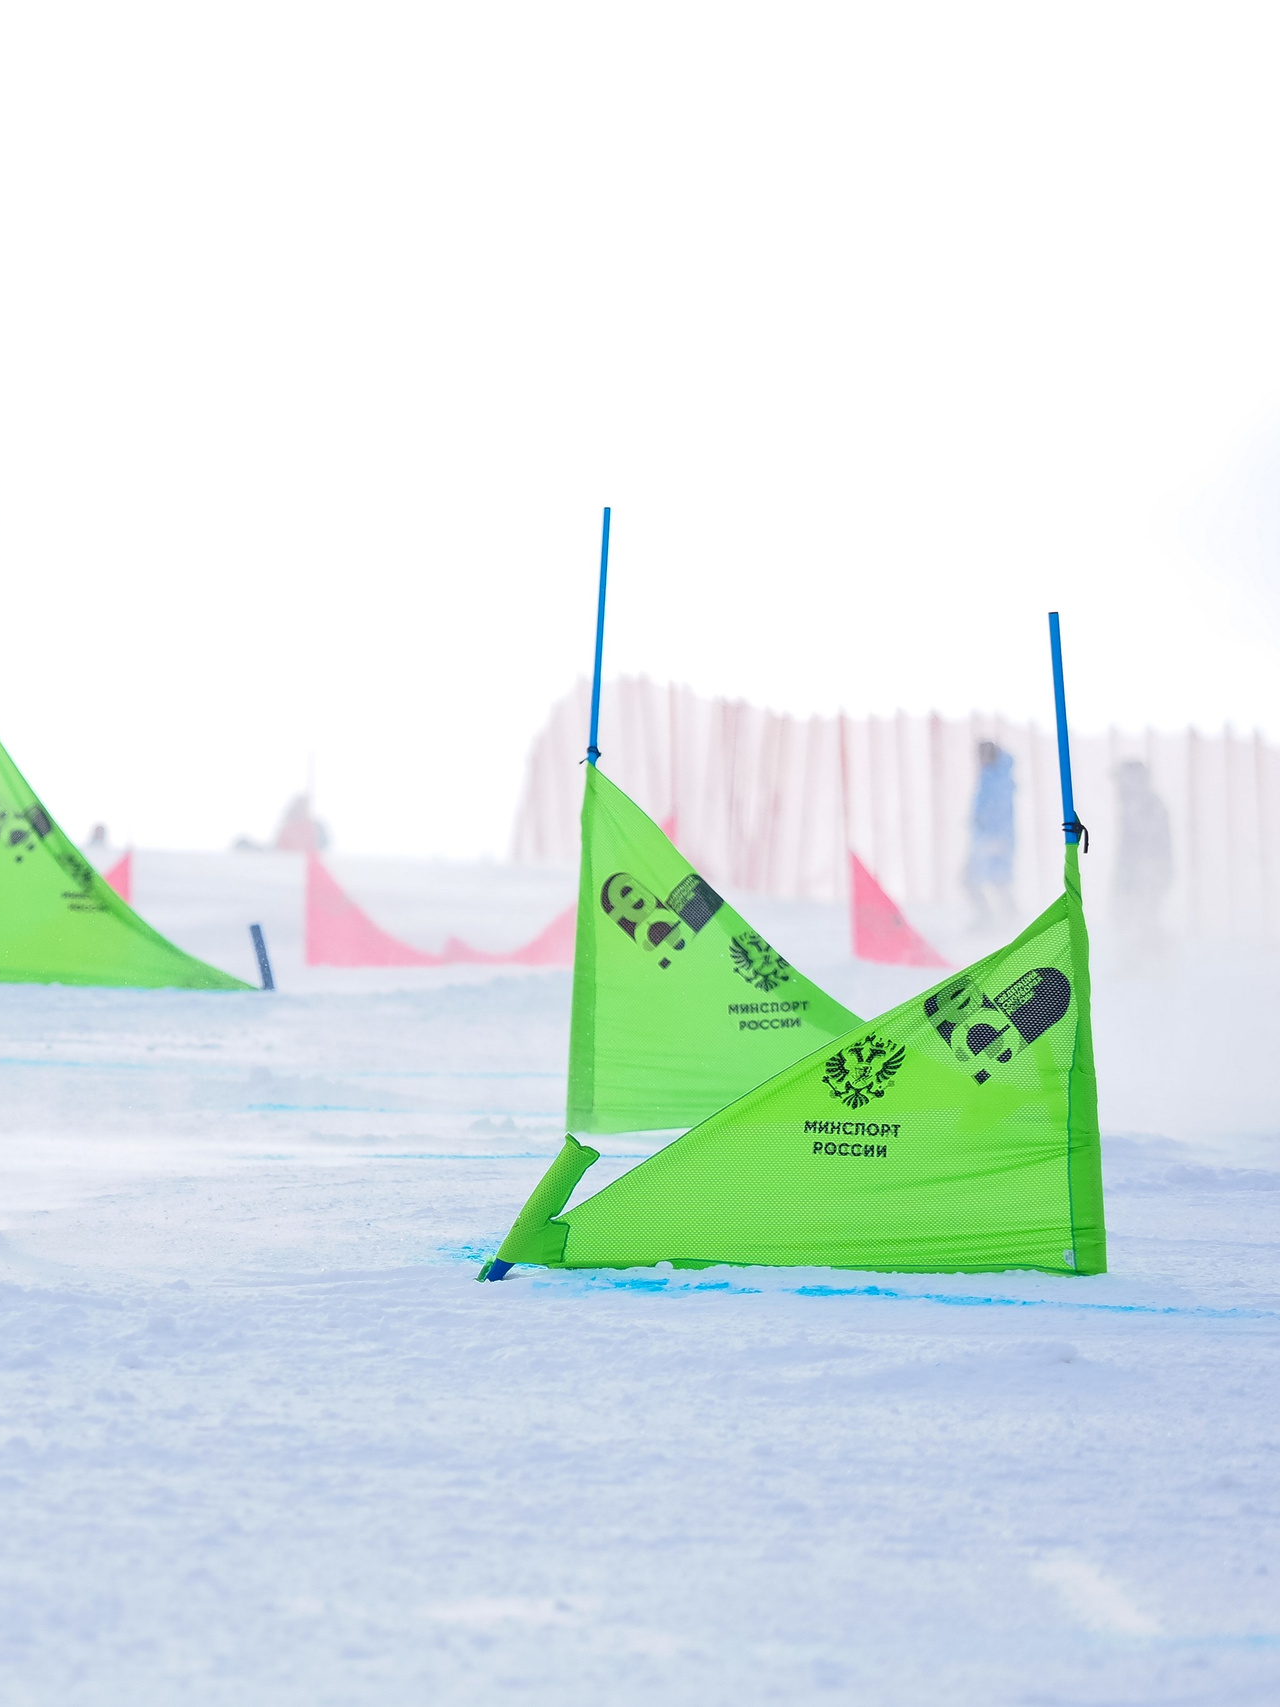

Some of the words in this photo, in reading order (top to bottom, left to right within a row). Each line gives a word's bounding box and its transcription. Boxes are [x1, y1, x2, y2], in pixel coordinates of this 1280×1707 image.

[728, 1001, 809, 1015] МИНСПОРТ
[739, 1018, 801, 1030] РОССИИ
[804, 1120, 900, 1137] МИНСПОРТ
[813, 1141, 887, 1157] РОССИИ
